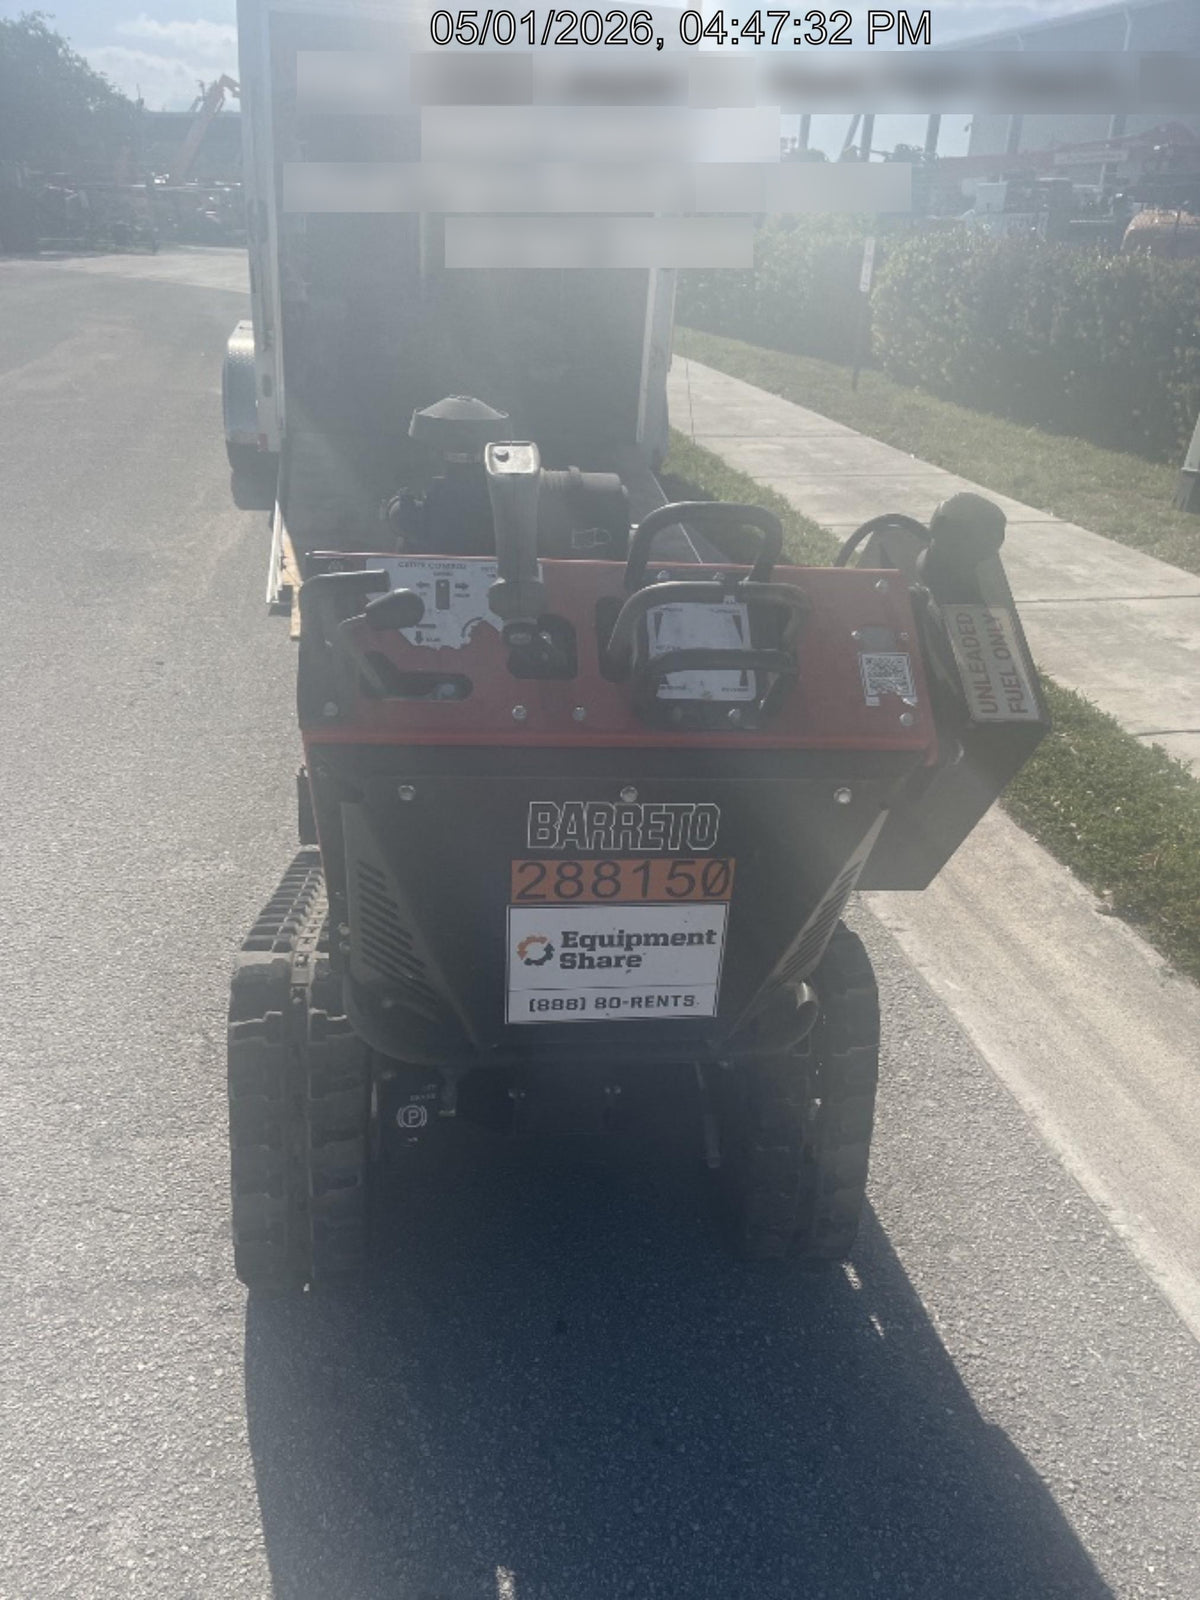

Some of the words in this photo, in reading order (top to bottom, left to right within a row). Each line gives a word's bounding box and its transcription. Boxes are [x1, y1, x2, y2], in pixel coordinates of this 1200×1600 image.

[981, 612, 1012, 660] ONLY
[956, 612, 998, 713] UNLEADED
[999, 664, 1029, 713] FUEL
[527, 801, 721, 851] BARRETO
[516, 859, 731, 900] 288150
[559, 951, 643, 970] Share
[560, 929, 718, 952] Equipment
[594, 994, 696, 1010] 80-RENTS
